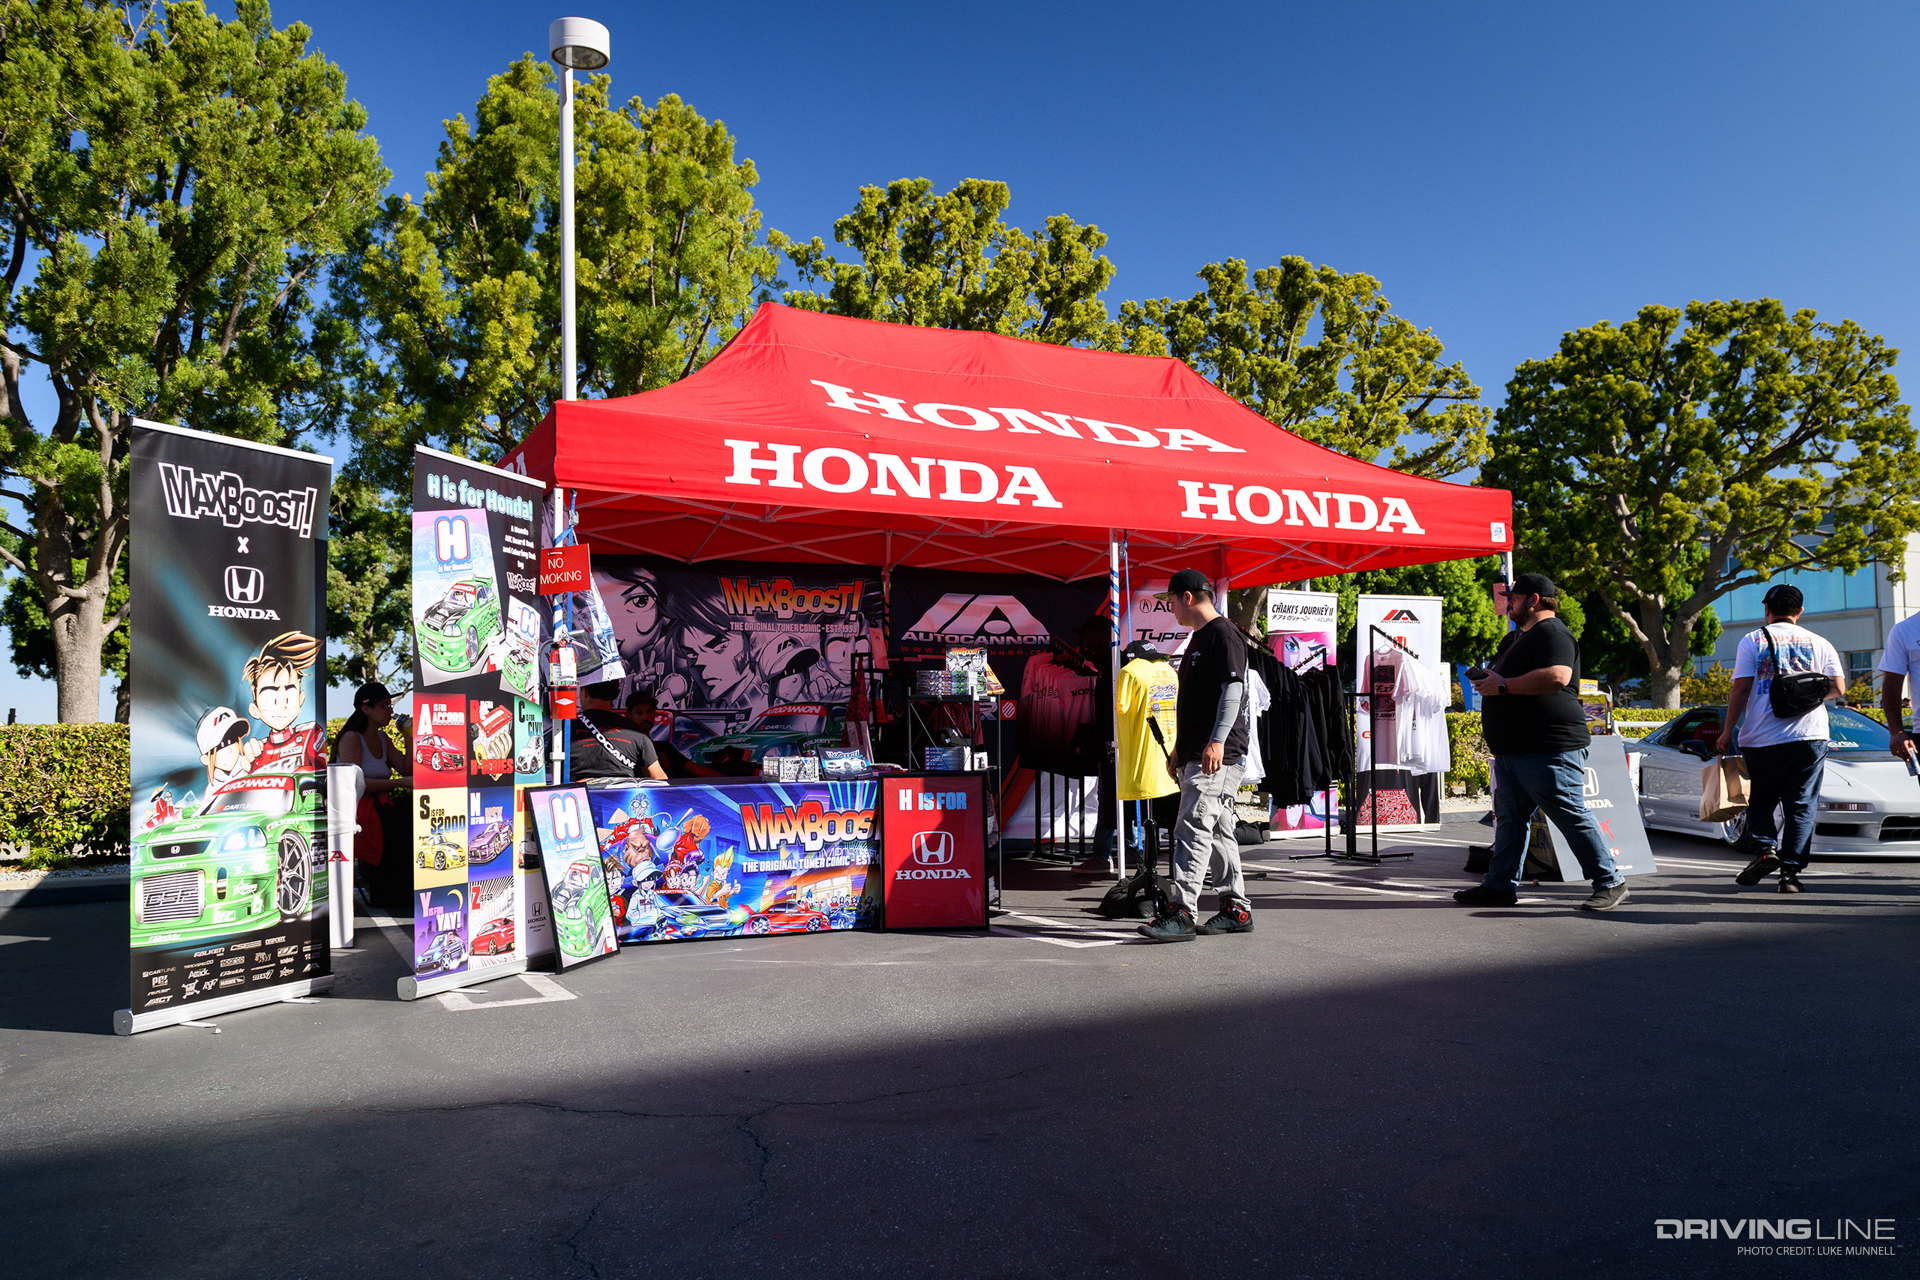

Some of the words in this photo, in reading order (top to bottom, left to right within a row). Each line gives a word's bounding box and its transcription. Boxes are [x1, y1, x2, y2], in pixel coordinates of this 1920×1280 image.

[809, 379, 1247, 453] HONDA
[724, 438, 1063, 508] HONDA
[427, 473, 440, 499] H
[442, 474, 457, 503] is
[458, 479, 485, 509] for
[485, 488, 534, 522] Honda!
[1177, 480, 1425, 535] HONDA
[434, 515, 471, 565] H
[548, 557, 564, 570] NO
[540, 570, 582, 585] MOKING
[208, 605, 281, 621] HONDA
[730, 621, 744, 631] THE
[744, 621, 776, 632] ORIGINAL
[776, 623, 799, 633] TUNER
[799, 623, 821, 633] COMIC
[901, 631, 1050, 645] AUTOCANNON
[1135, 628, 1189, 642] Type
[417, 703, 433, 735] A
[432, 711, 465, 726] ACCORD
[519, 700, 525, 723] C
[470, 758, 515, 775] B-SERIES
[419, 794, 430, 820] S
[470, 792, 481, 817] N
[484, 806, 503, 824] NSX
[899, 788, 912, 811] H
[918, 792, 934, 810] IS
[936, 792, 967, 810] FOR
[430, 815, 466, 834] S2000
[549, 792, 583, 843] H
[742, 862, 758, 873] THE
[760, 860, 797, 871] ORIGINAL
[799, 858, 825, 869] TUNER
[825, 857, 850, 868] COMIC
[895, 869, 971, 880] HONDA
[419, 891, 432, 918] Y
[472, 886, 480, 910] Z
[436, 910, 461, 932] YAY!
